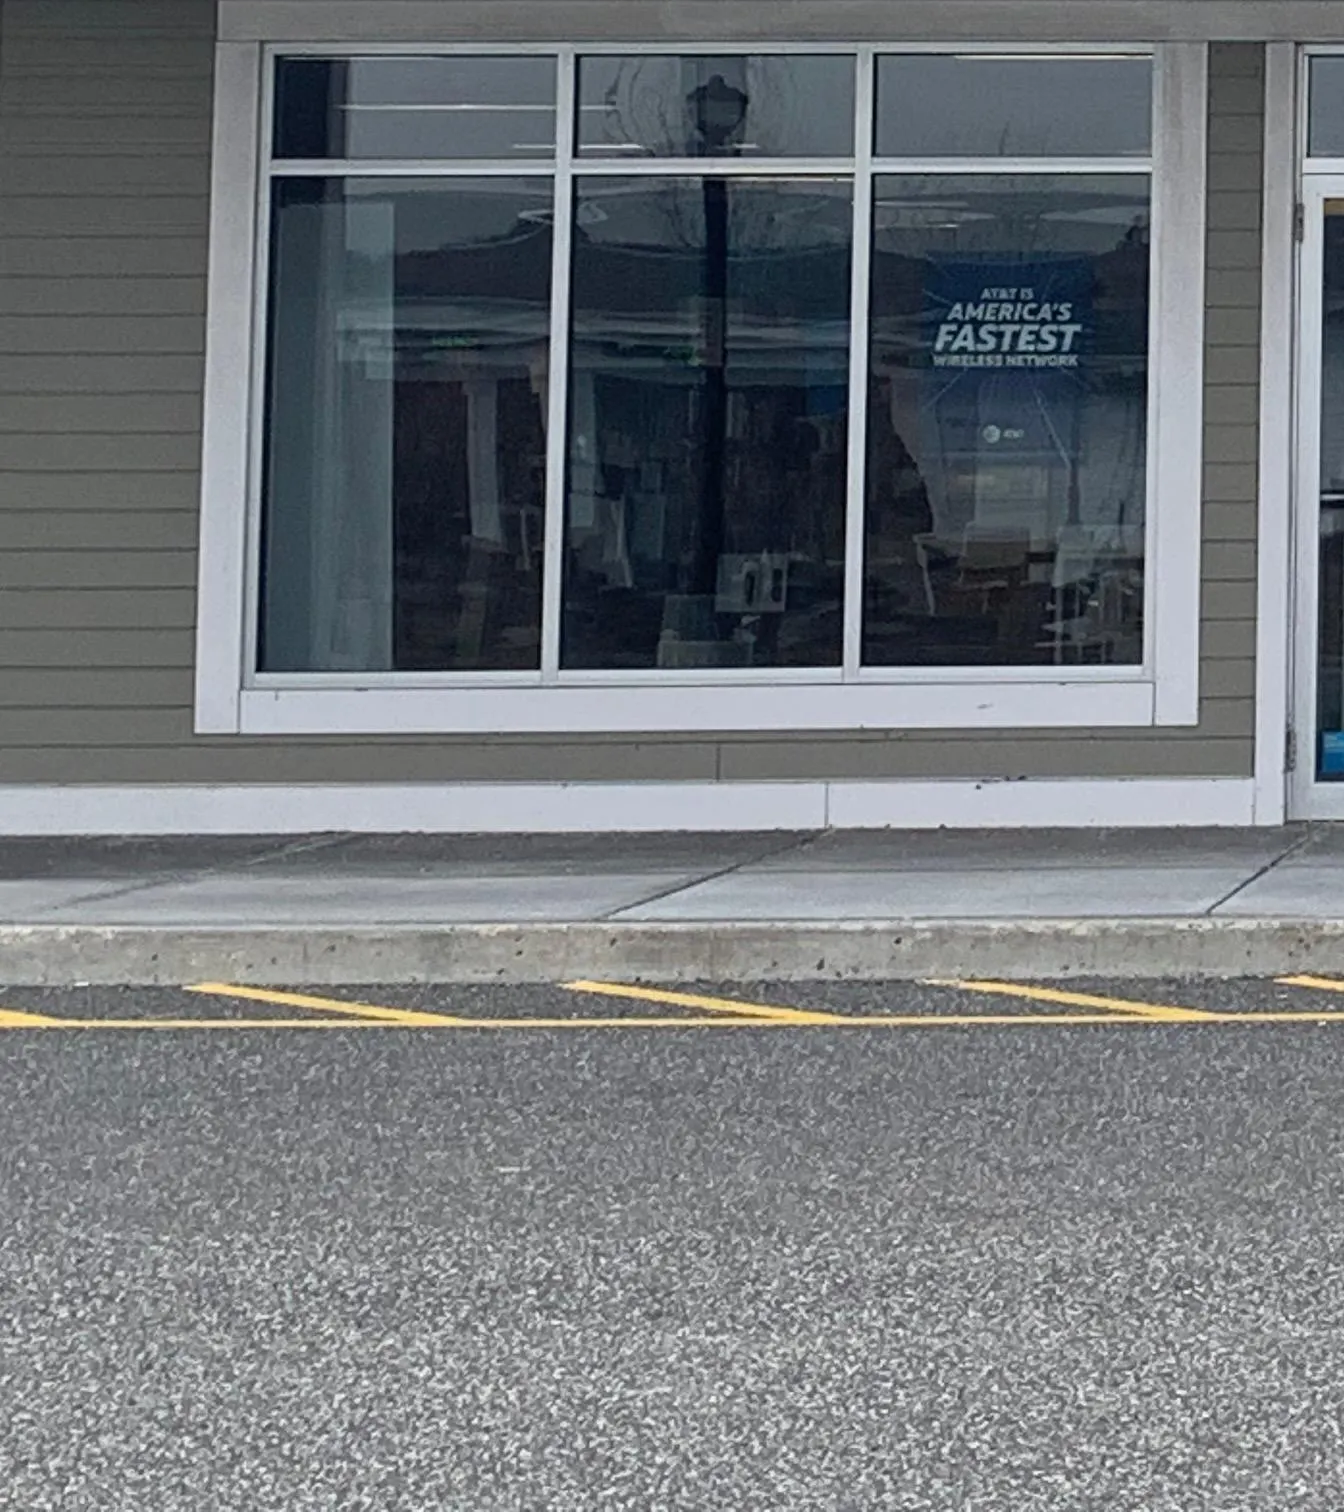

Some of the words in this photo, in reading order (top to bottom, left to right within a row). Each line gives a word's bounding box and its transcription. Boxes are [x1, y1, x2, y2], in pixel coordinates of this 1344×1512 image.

[947, 303, 1072, 321] AMERICA'S
[934, 324, 1083, 352] FASTEST
[1005, 355, 1079, 367] NETWORK
